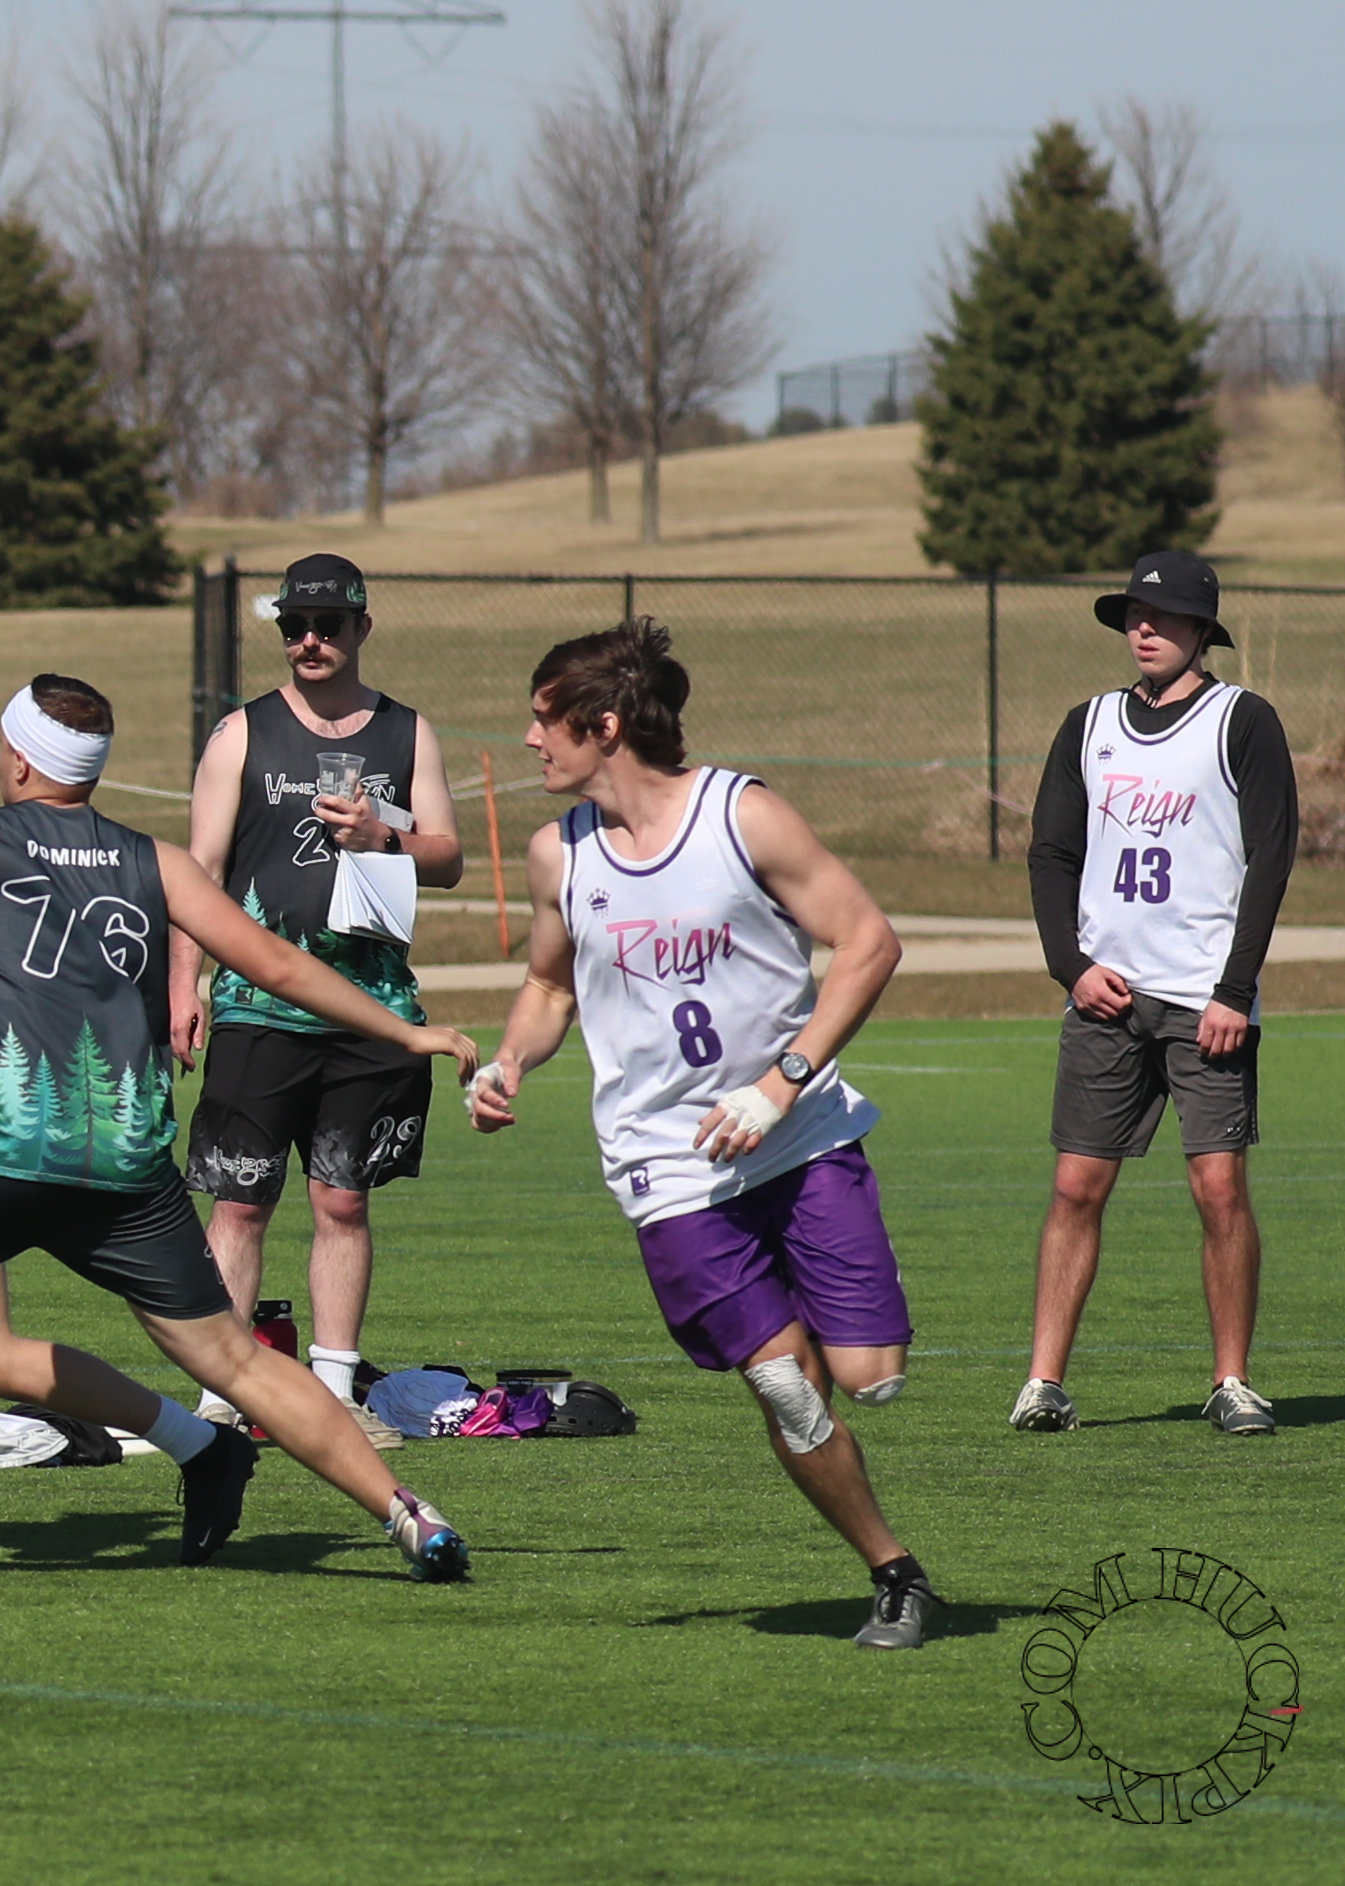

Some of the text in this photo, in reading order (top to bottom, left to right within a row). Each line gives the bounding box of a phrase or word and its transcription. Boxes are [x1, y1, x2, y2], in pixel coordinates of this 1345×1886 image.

[1097, 773, 1197, 839] Reign
[1113, 847, 1172, 904] 43
[0, 875, 150, 985] 76
[606, 918, 737, 998] Reign
[672, 999, 723, 1068] 8
